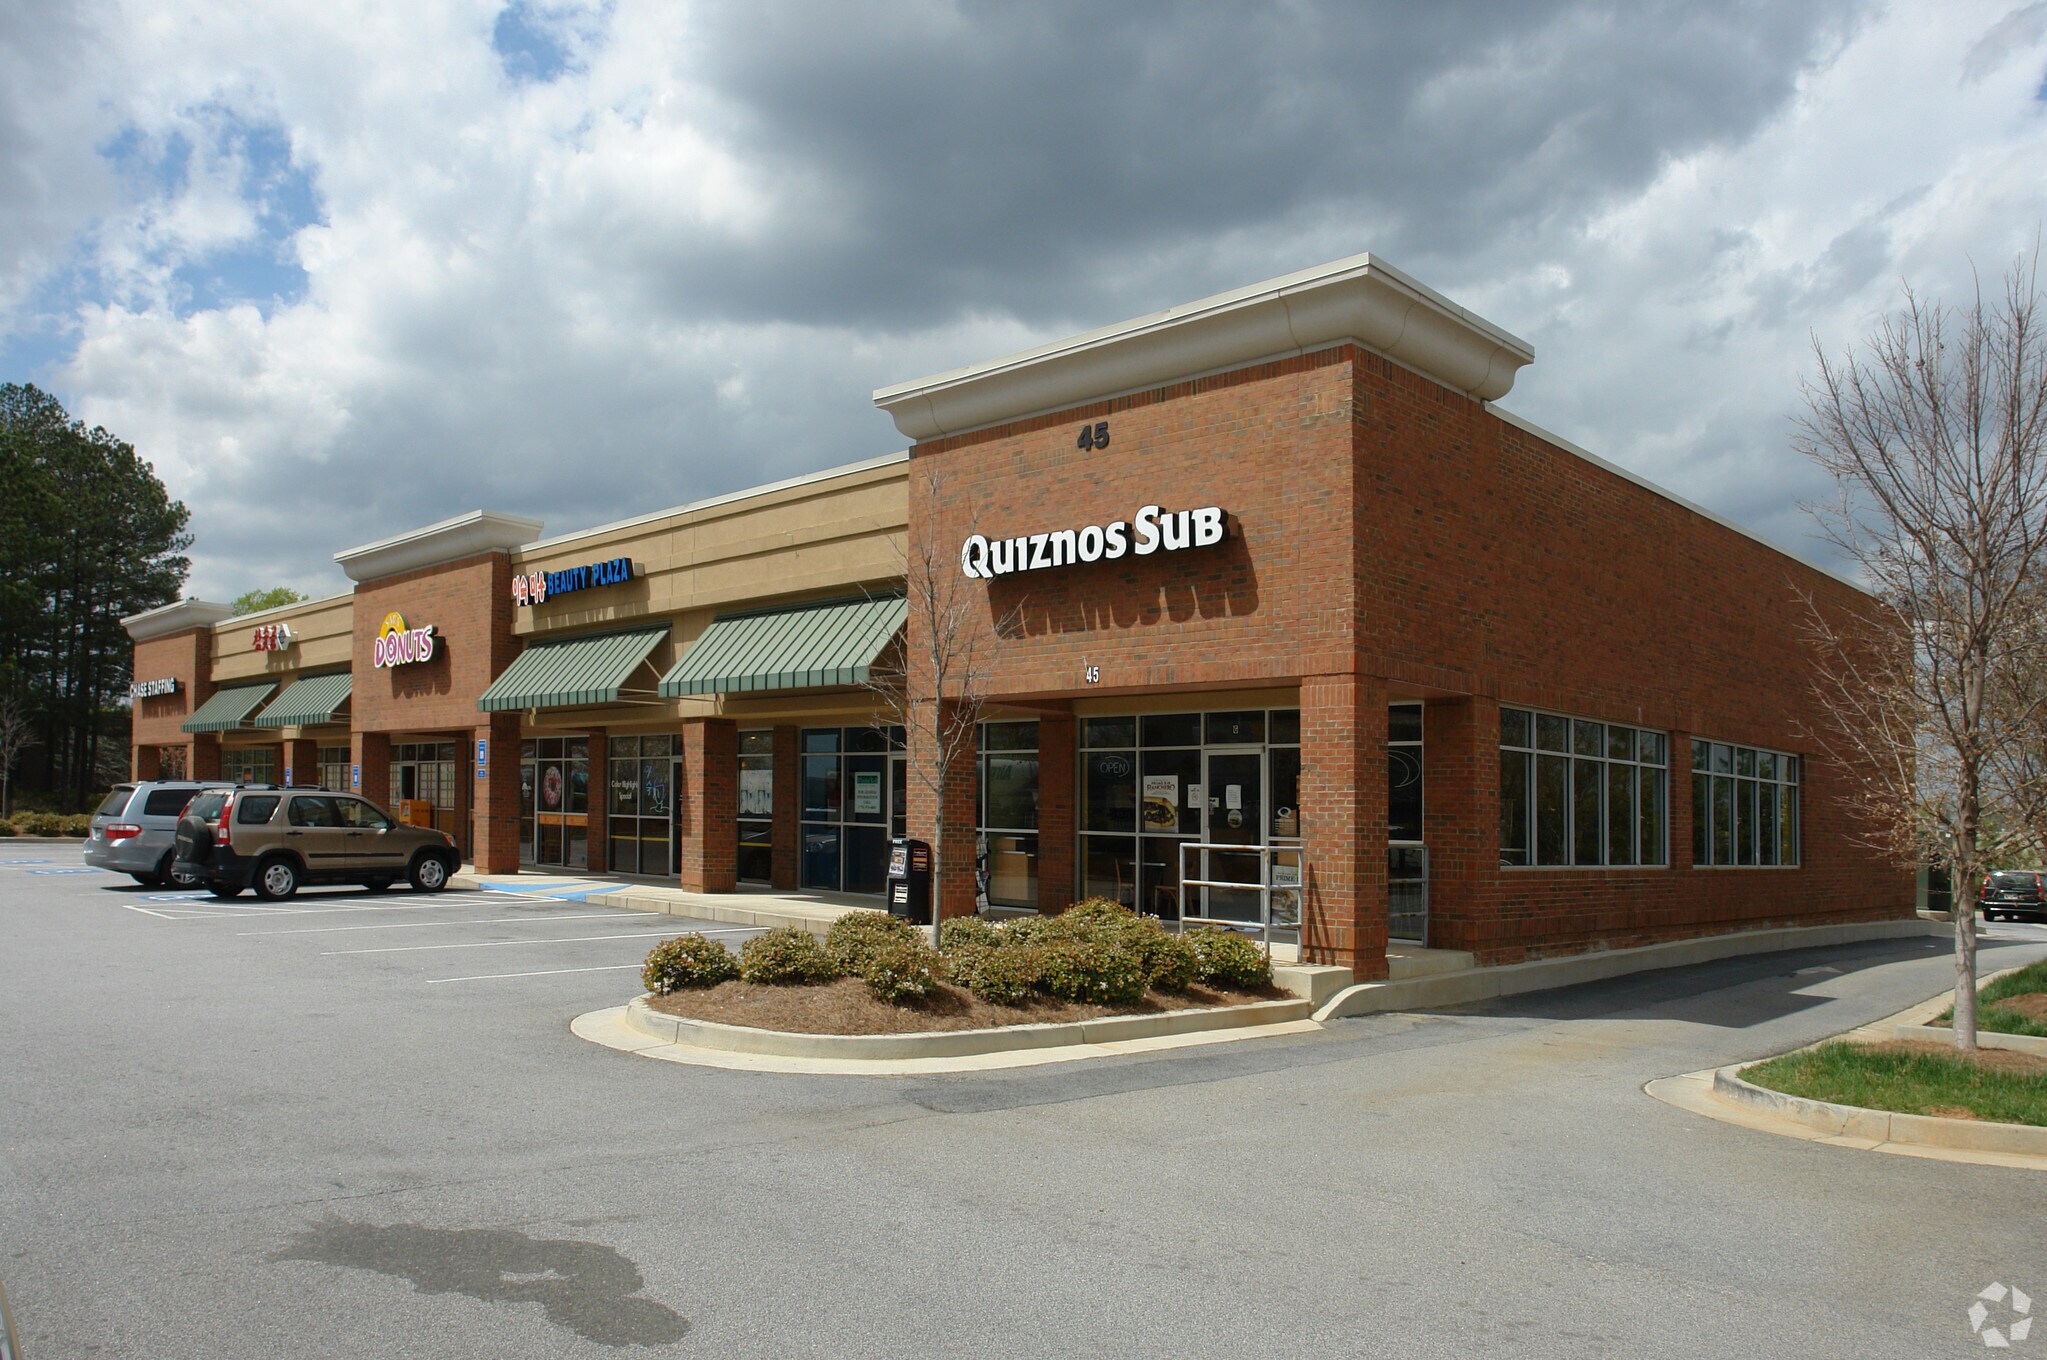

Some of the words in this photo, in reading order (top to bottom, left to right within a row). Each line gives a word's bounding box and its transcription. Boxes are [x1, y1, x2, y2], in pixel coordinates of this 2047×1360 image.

[1076, 421, 1110, 451] 45
[547, 565, 588, 595] BEAUTY
[592, 557, 628, 587] PLAZA
[374, 624, 433, 668] DONUTS
[1086, 666, 1099, 683] 45
[130, 682, 147, 699] CHASE
[148, 677, 175, 697] STAFFING
[1100, 762, 1126, 774] OPEN
